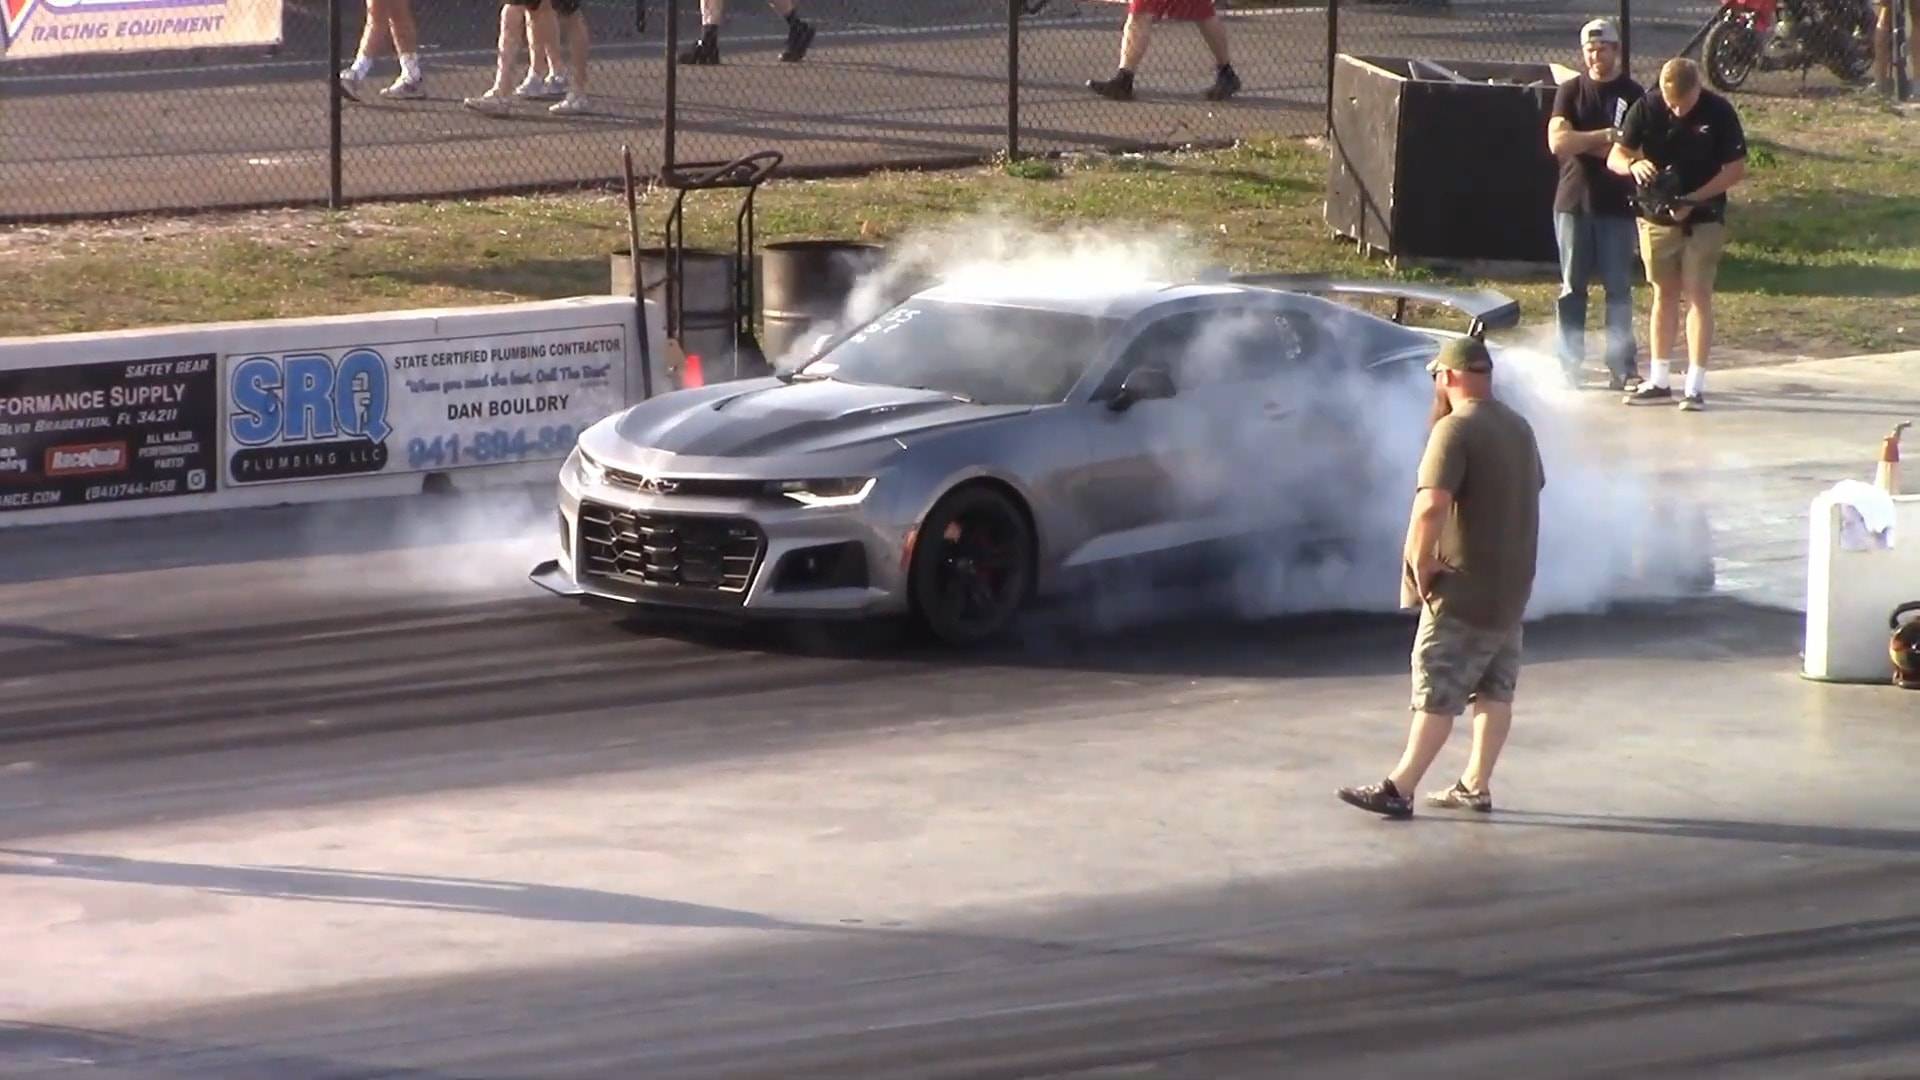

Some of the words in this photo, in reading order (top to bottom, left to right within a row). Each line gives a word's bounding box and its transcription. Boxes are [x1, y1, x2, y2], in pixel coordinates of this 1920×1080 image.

[31, 22, 108, 42] RACING
[116, 15, 225, 38] EQUIPMENT
[395, 353, 428, 370] STATE
[431, 348, 487, 366] CERTIFIED
[491, 344, 547, 363] PLUMBING
[549, 338, 622, 356] CONTRACTOR
[125, 363, 173, 378] SAFTEY
[176, 359, 210, 374] GEAR
[110, 383, 186, 407] SUPPLY
[230, 348, 393, 447] SRQ
[447, 402, 482, 420] DAN
[489, 394, 571, 417] BOULDRY
[137, 409, 178, 424] 34211
[242, 452, 337, 472] PLUMBING
[350, 449, 379, 463] LLC
